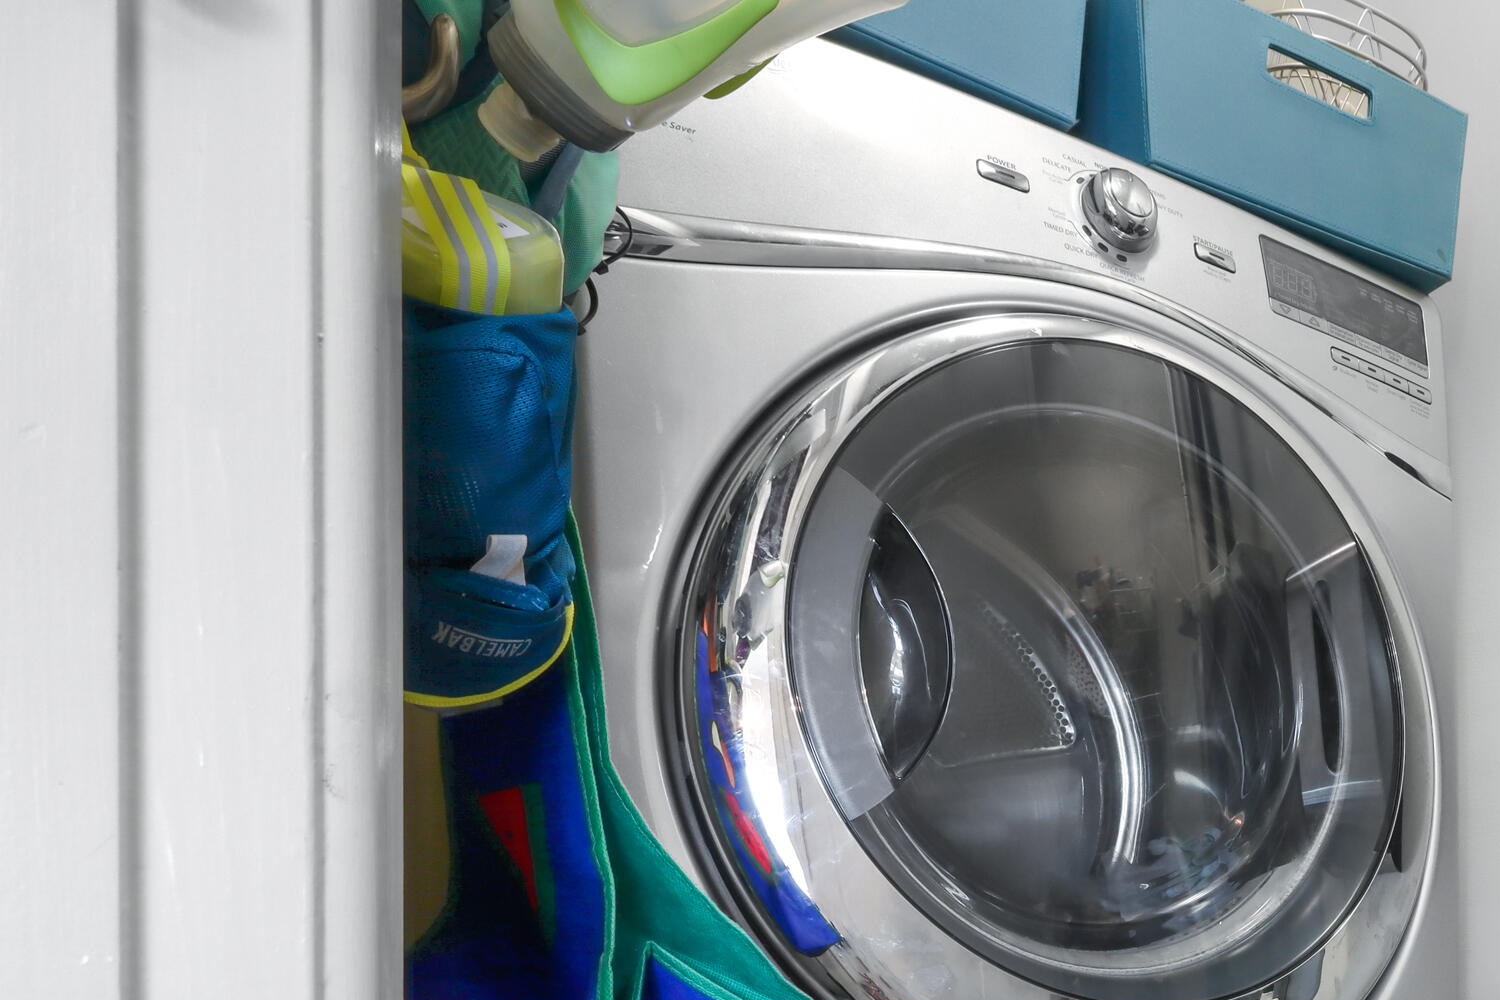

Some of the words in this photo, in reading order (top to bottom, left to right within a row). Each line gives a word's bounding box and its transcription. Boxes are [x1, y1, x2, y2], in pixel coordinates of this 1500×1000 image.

[669, 122, 697, 135] Saver
[987, 154, 1017, 171] POWER
[1043, 221, 1064, 233] TIMED
[1065, 228, 1078, 238] DRY
[1064, 242, 1084, 254] QUICK
[431, 621, 533, 658] CAMELBAK
